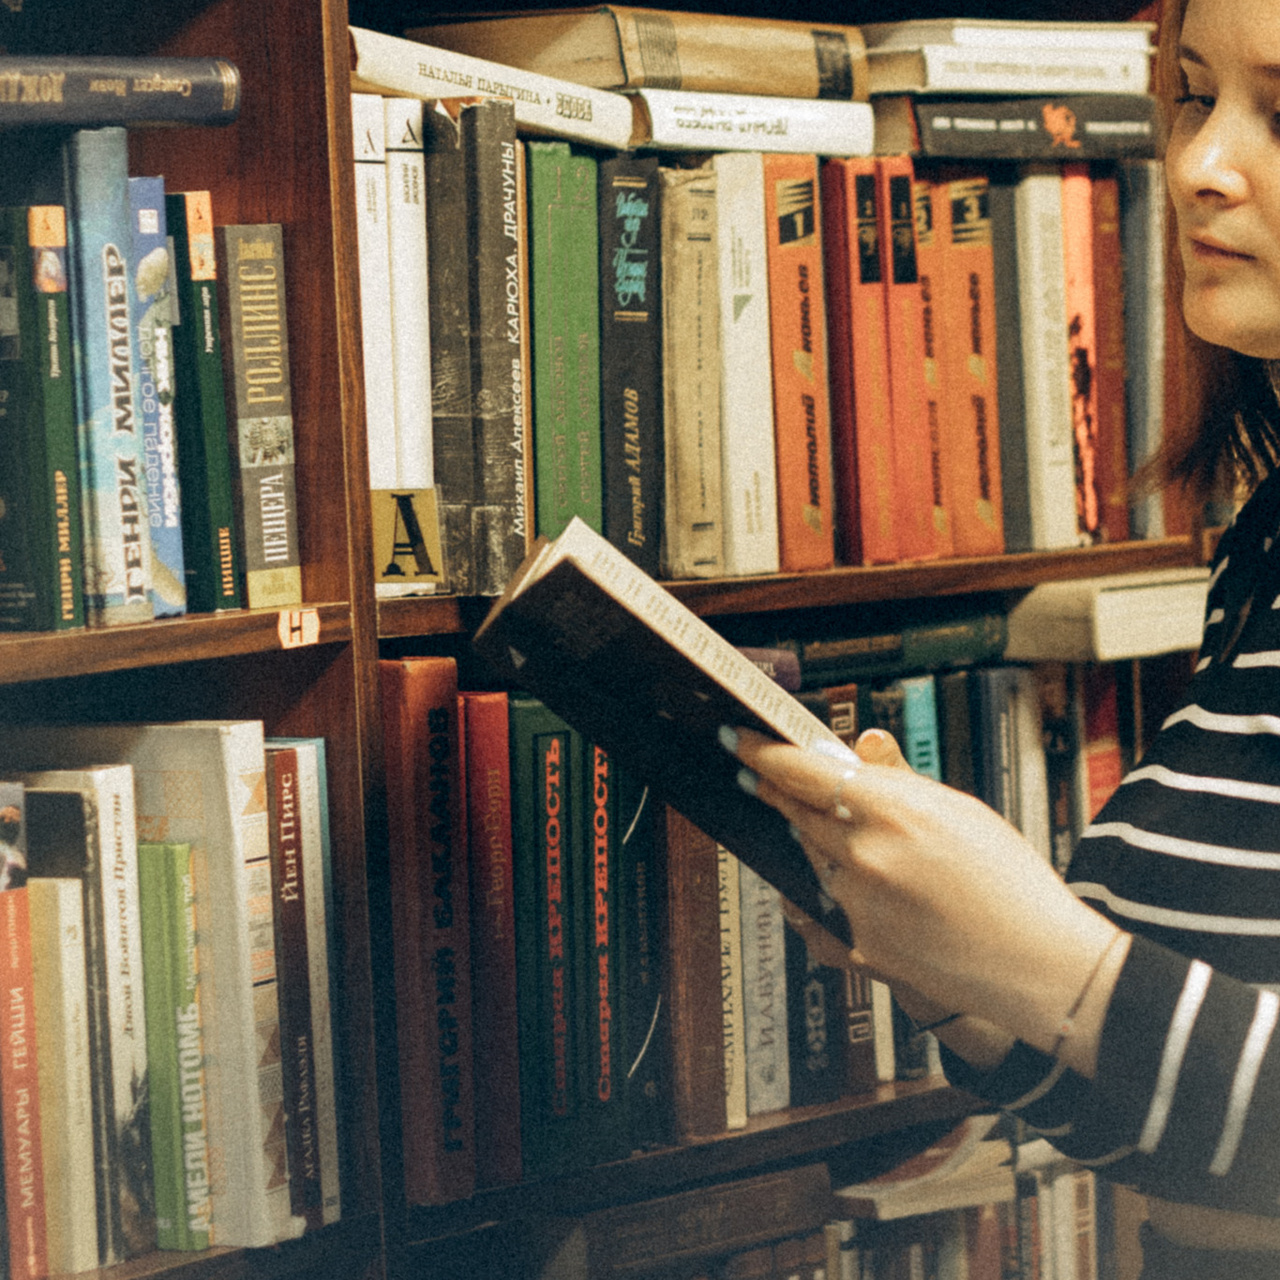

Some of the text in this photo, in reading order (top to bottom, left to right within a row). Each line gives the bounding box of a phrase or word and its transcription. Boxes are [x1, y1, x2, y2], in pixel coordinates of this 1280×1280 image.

[417, 62, 473, 90] НАТАЛЬЯ
[477, 76, 542, 106] ПАРЫГИНА
[239, 265, 284, 403] РОЛЛИНС
[502, 141, 526, 537] Михаил Алексеев КАРЮХА. ДРАЧУНЫ
[102, 243, 146, 603] ГЕНРИ МИЛЛЕР
[143, 417, 163, 528] падение
[154, 327, 179, 528] НИК ХОРНБИ
[624, 388, 644, 547] Григорий АДАМОВ
[55, 471, 71, 552] МИЛЛЕР
[218, 527, 234, 596] НИЦШЕ
[260, 472, 289, 562] ПЕЩЕРА
[382, 493, 438, 577] А
[60, 558, 75, 621] ГЕНРИ
[113, 794, 127, 880] Пристли
[545, 738, 563, 959] КРЕПОСТЬ
[122, 984, 136, 1041] Джон
[176, 1003, 204, 1123] НОТОМБ
[597, 952, 612, 1102] Старая
[10, 987, 35, 1209] МЕМУАРЫ ГЕЙШИ
[184, 1130, 210, 1232] АМЕЛИ
